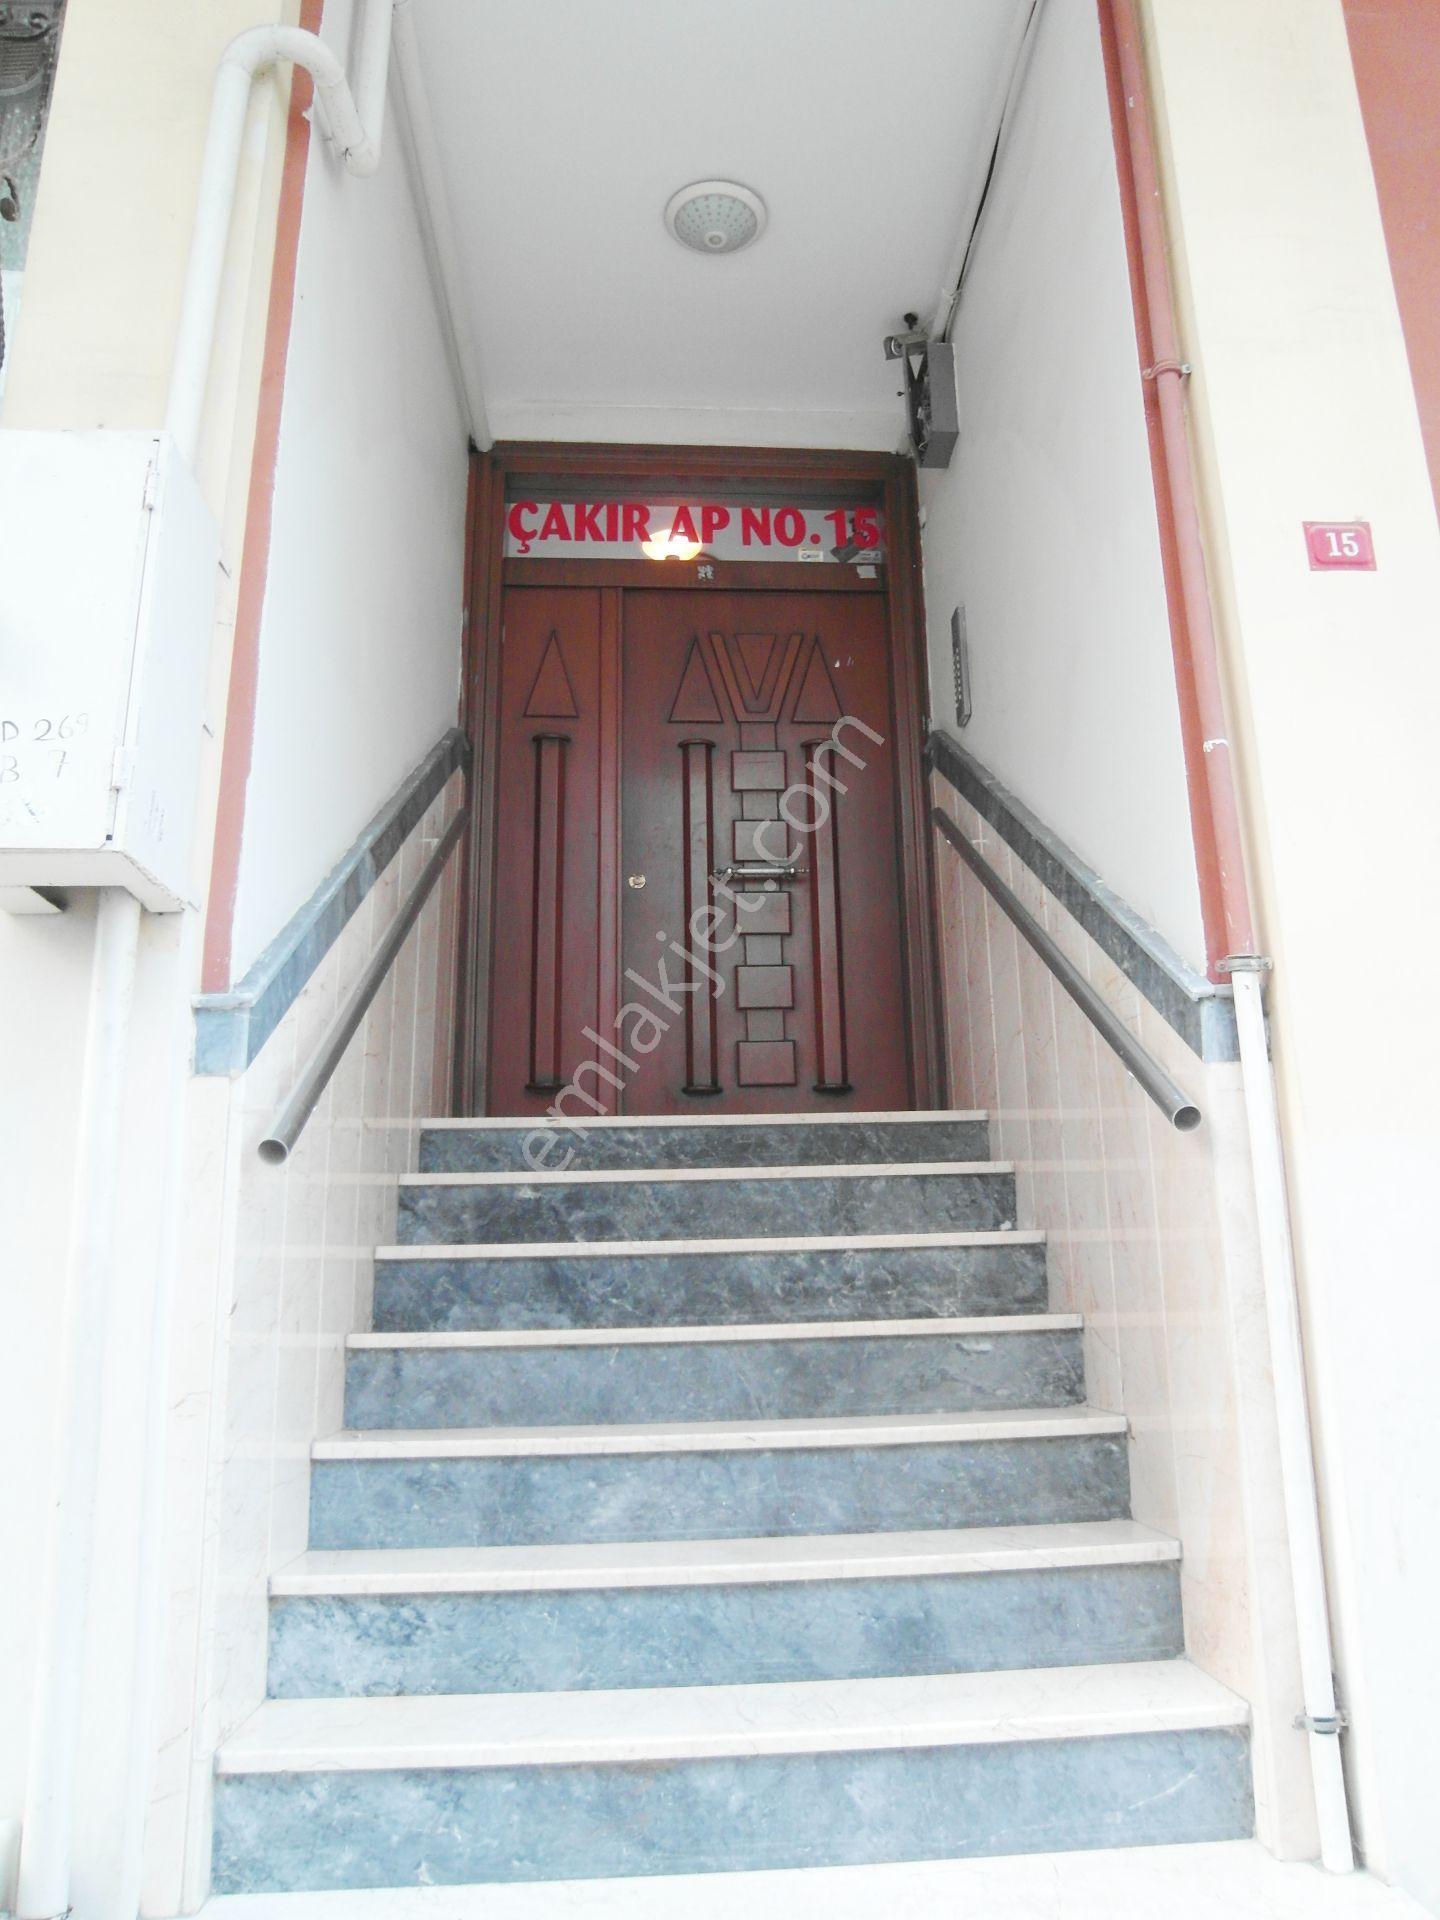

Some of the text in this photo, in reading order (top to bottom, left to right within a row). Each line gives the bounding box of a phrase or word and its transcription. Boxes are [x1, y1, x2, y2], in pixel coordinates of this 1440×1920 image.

[508, 501, 651, 554] ÇAKIR
[668, 504, 730, 544] AP
[1325, 531, 1359, 557] 15
